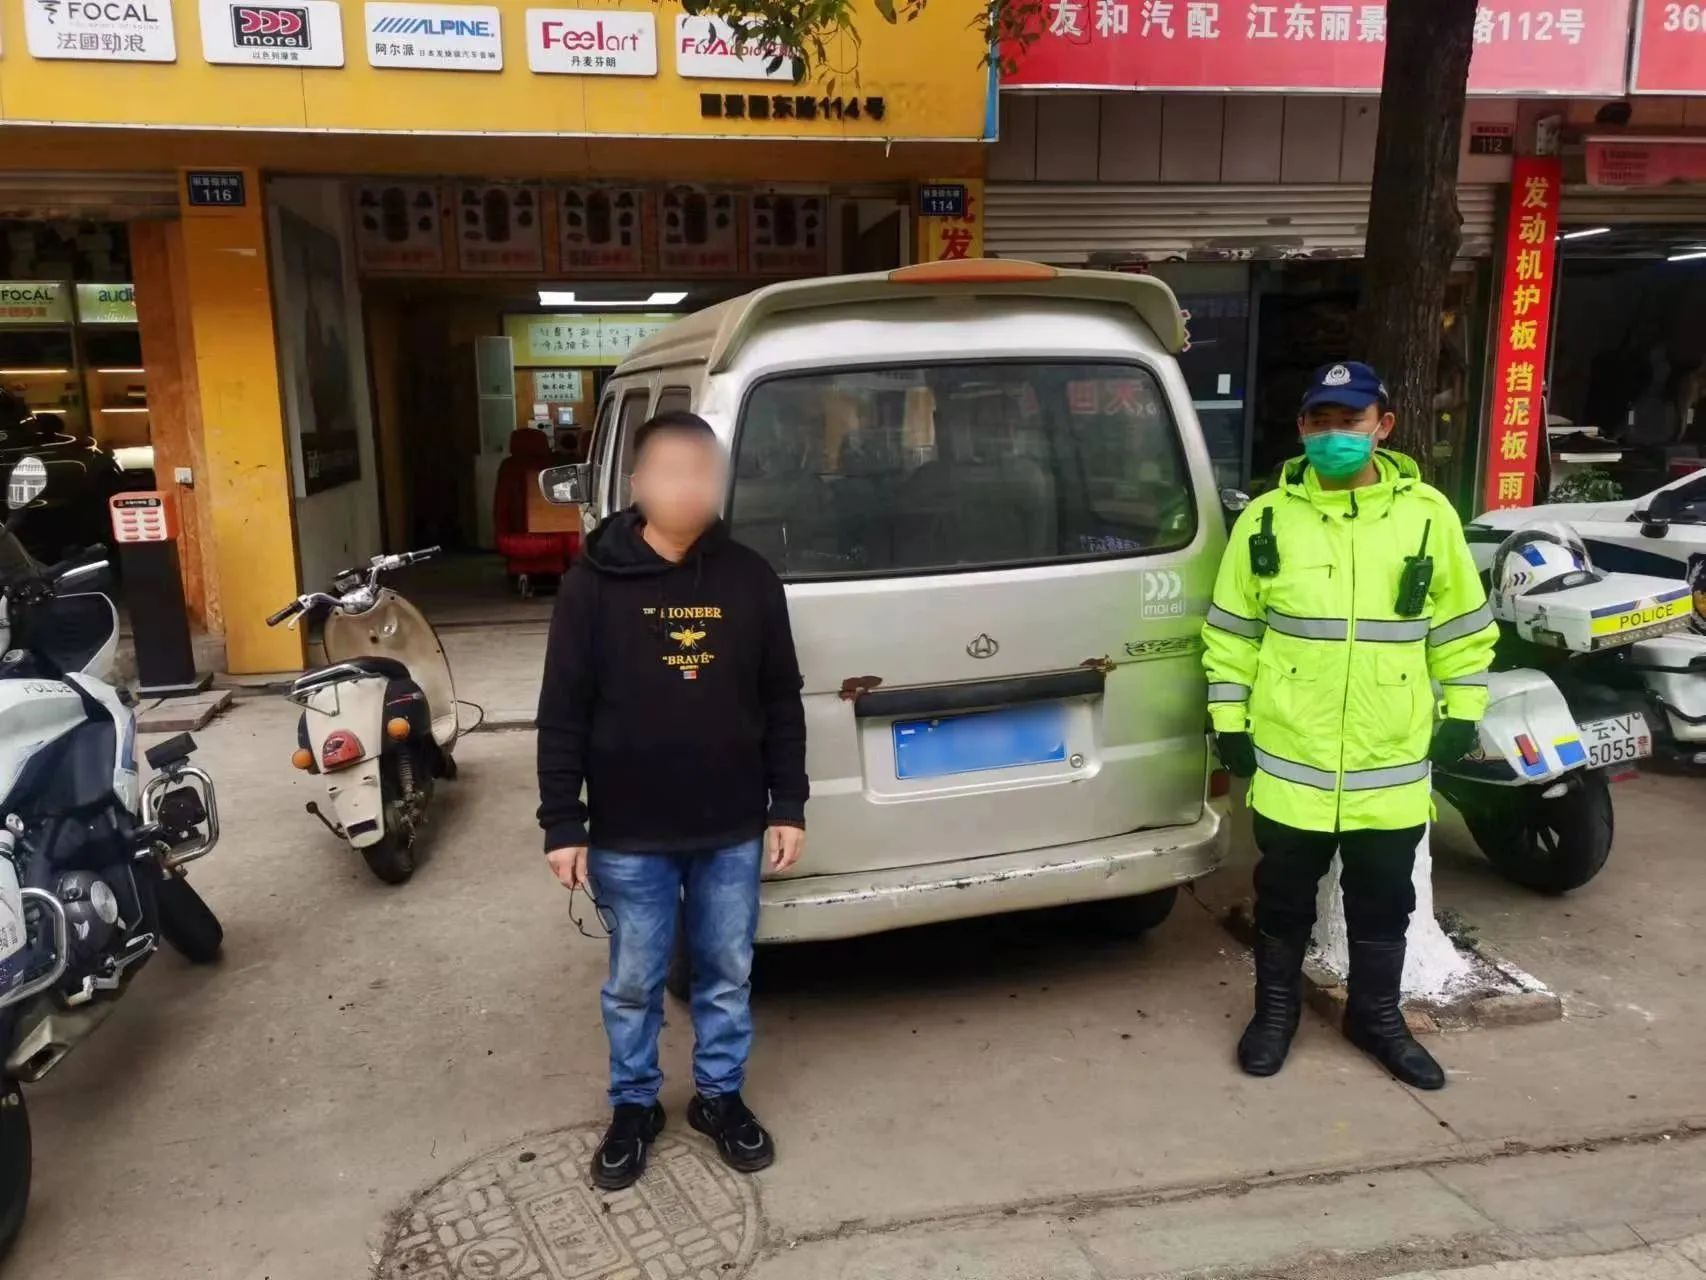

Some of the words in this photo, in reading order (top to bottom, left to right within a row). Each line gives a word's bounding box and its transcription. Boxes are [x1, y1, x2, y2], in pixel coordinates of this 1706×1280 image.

[68, 2, 158, 22] FOCAL
[1049, 0, 1220, 39] 友和汽配
[57, 32, 146, 54] 法國勁浪
[243, 34, 303, 47] morel
[542, 21, 639, 51] Feelart
[375, 43, 414, 56] 阿尔派
[571, 56, 616, 67] 丹麦芬朗
[1479, 137, 1503, 152] 112
[203, 189, 232, 201] 116
[931, 200, 953, 212] 114
[1510, 176, 1549, 350] 发动机护板
[1, 289, 54, 301] FOCAL
[1501, 361, 1534, 460] 挡泥板
[1619, 603, 1674, 630] POLICE
[1589, 737, 1636, 767] 5055
